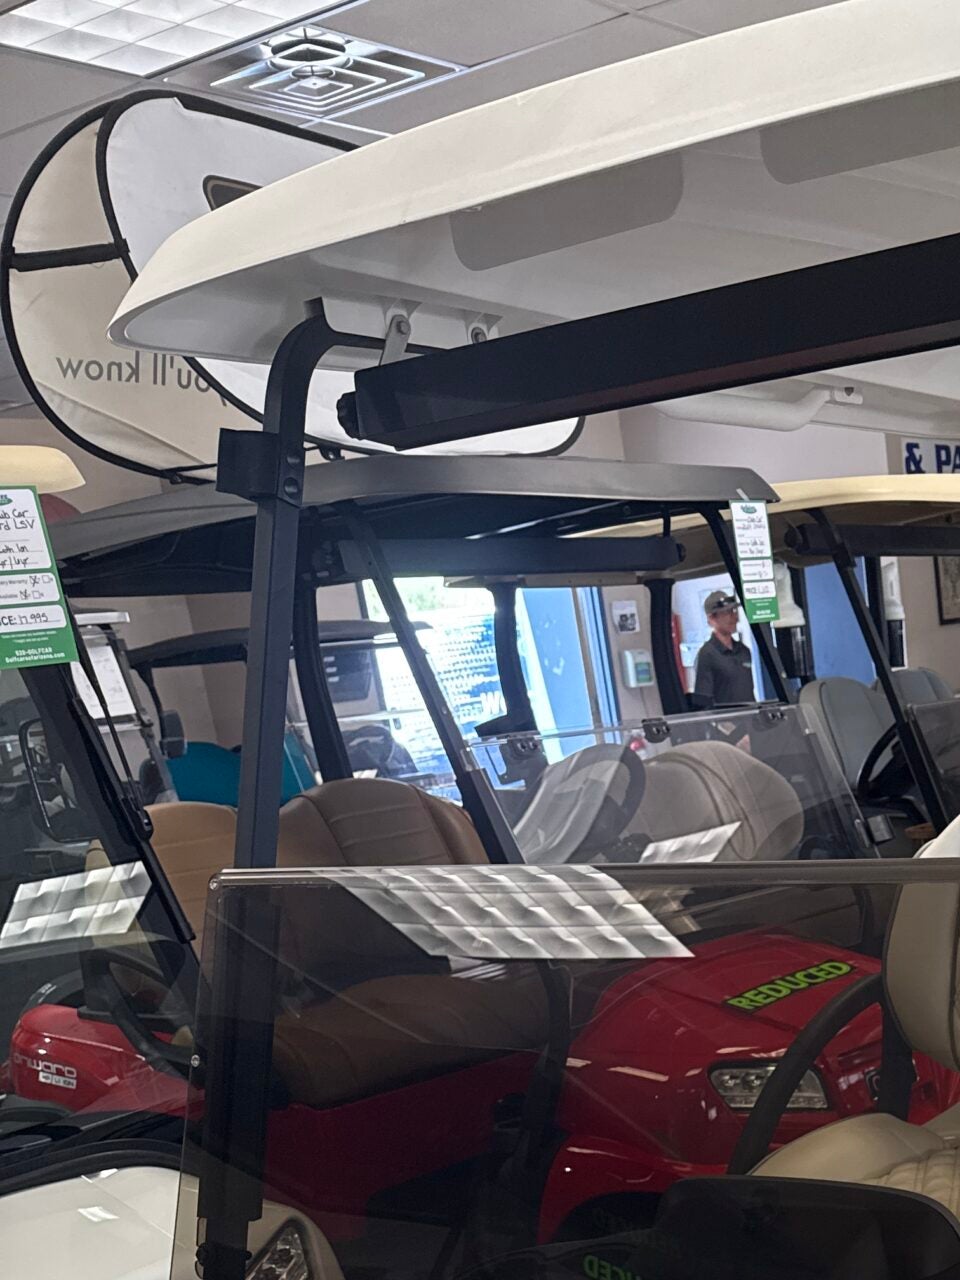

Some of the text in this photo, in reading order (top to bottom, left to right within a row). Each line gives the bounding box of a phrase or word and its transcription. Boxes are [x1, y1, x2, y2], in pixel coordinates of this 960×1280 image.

[905, 442, 925, 474] &
[13, 518, 35, 530] LSV
[0, 615, 17, 626] CE:
[727, 961, 852, 1010] REDUCED
